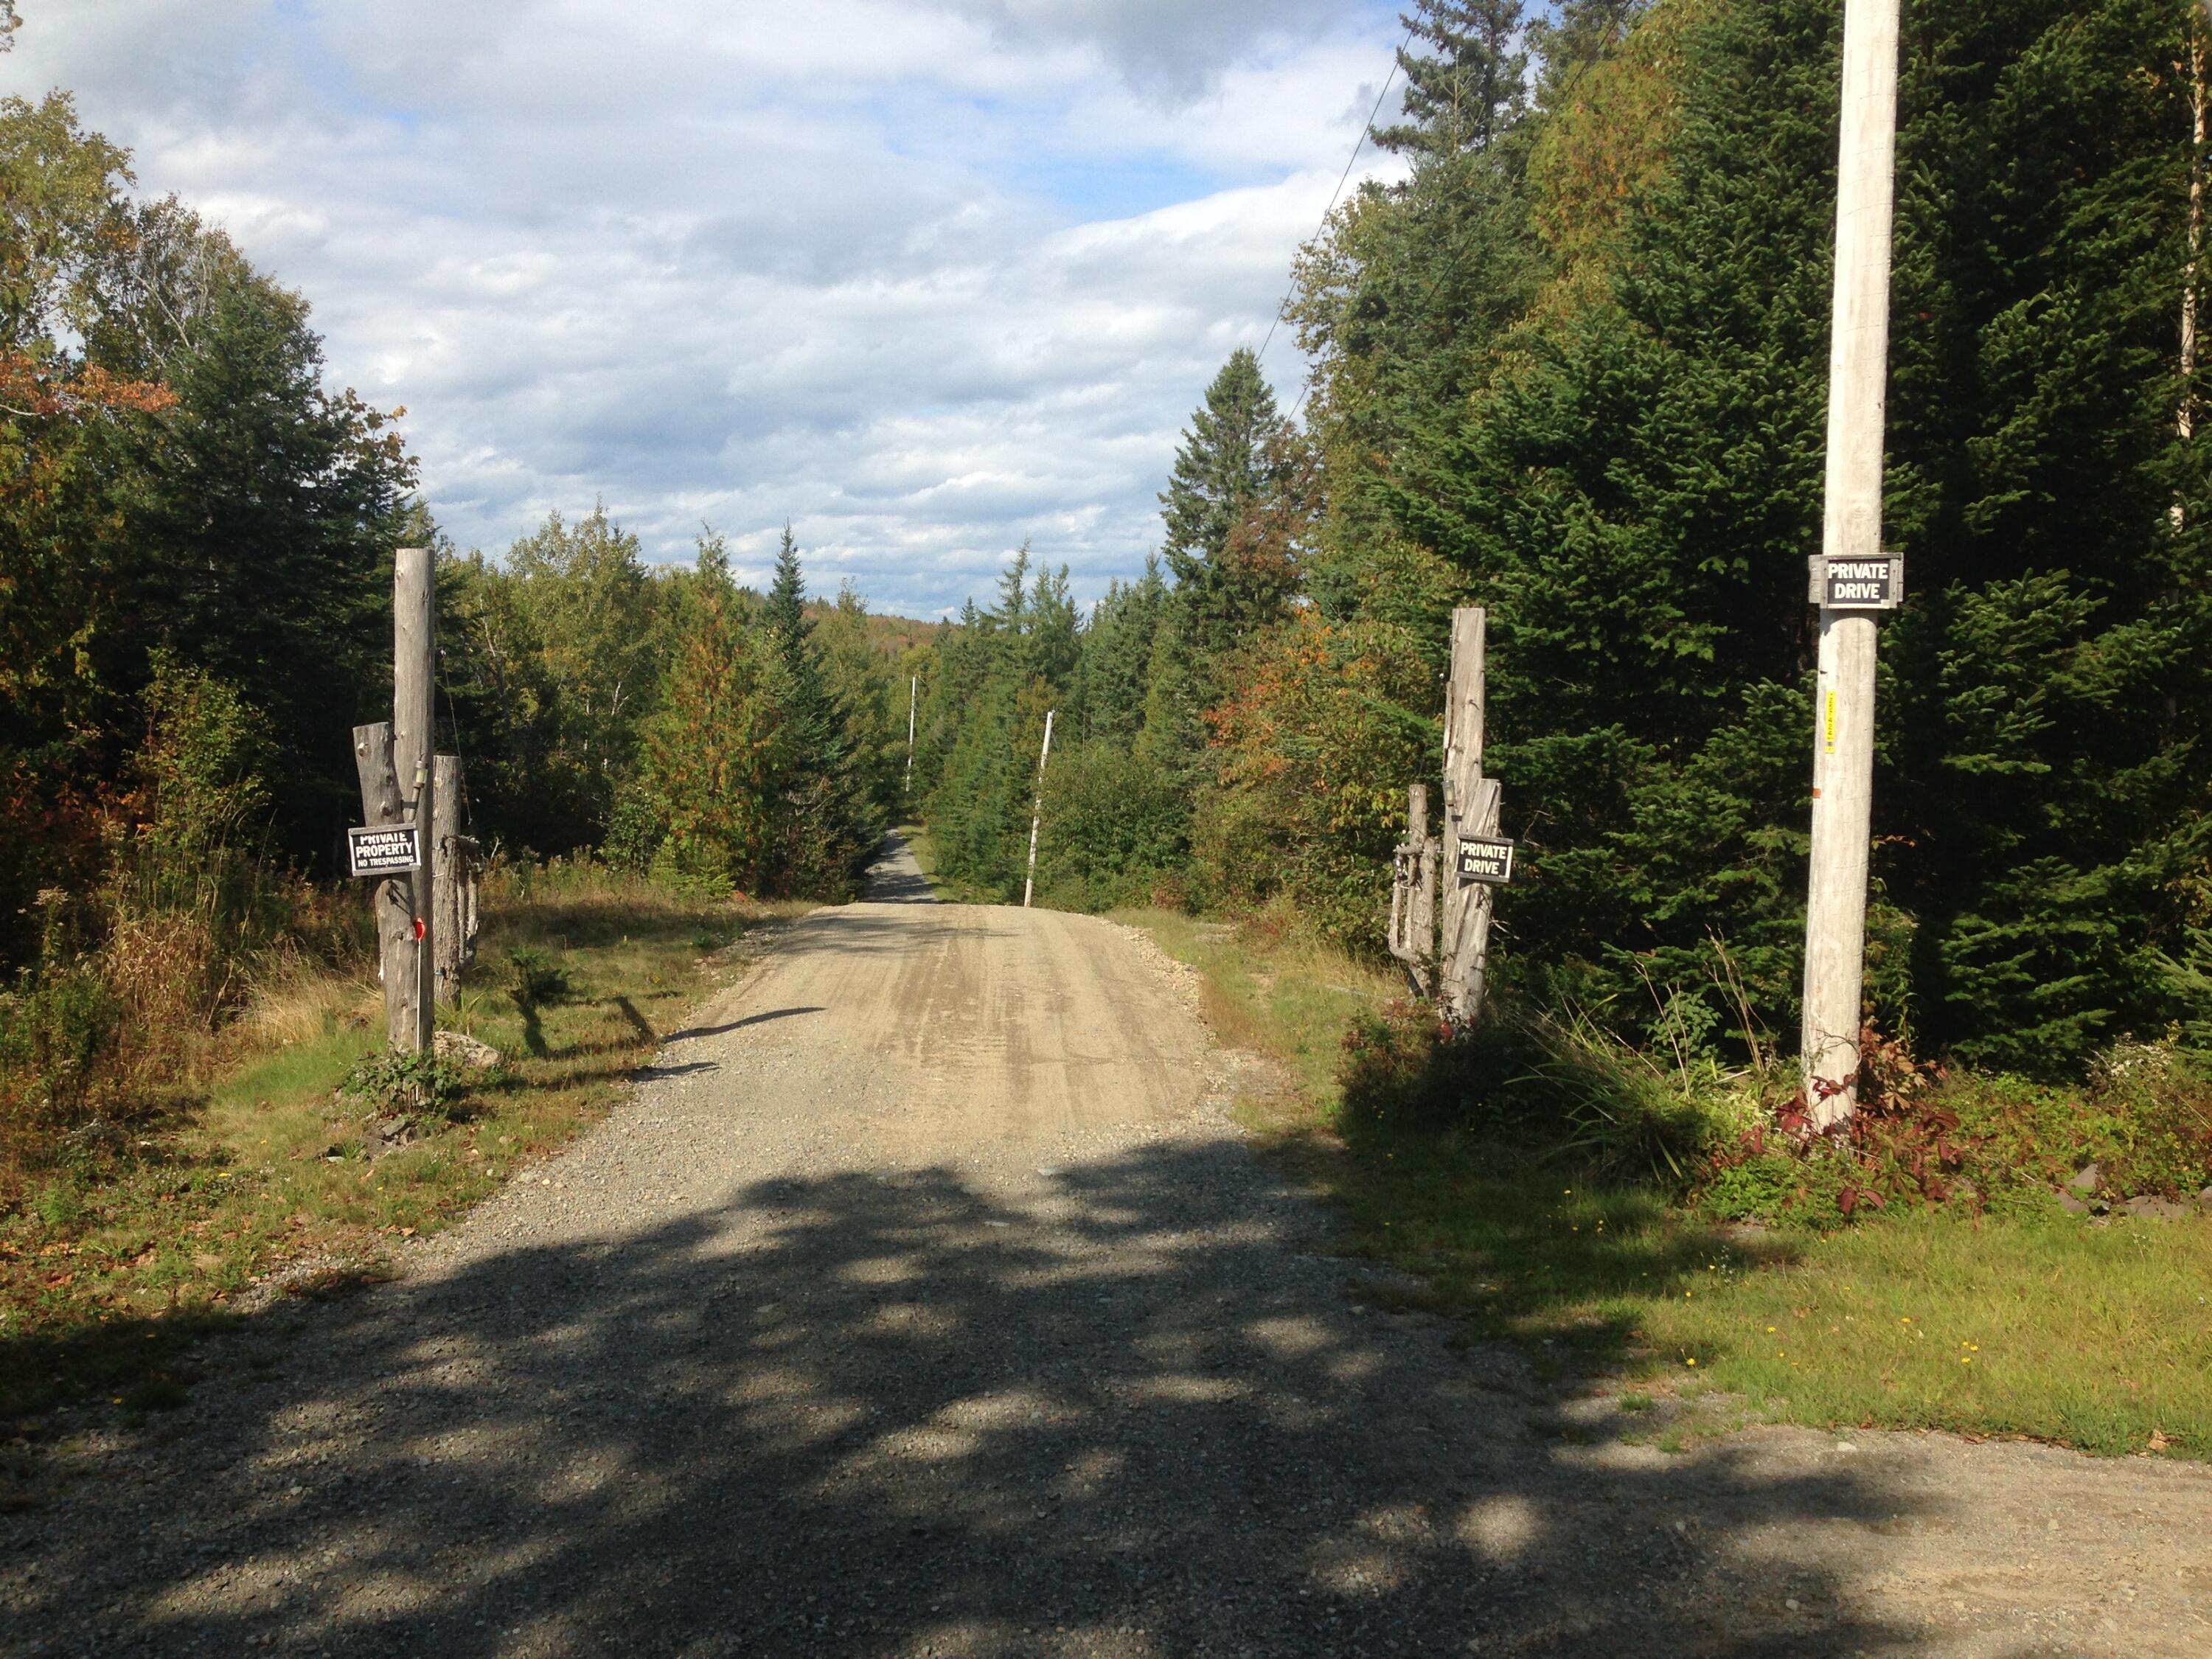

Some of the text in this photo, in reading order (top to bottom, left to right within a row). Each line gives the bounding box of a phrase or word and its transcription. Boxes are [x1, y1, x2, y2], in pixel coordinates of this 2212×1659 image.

[1829, 563, 1888, 579] PRIVATE
[1834, 583, 1880, 599] DRIVE
[360, 832, 407, 845] PRIVATE
[355, 842, 412, 858] PROPERTY
[1461, 842, 1507, 860] PRIVATE
[358, 855, 414, 867] NO TRESPASSING
[1464, 858, 1500, 874] DRIVE
